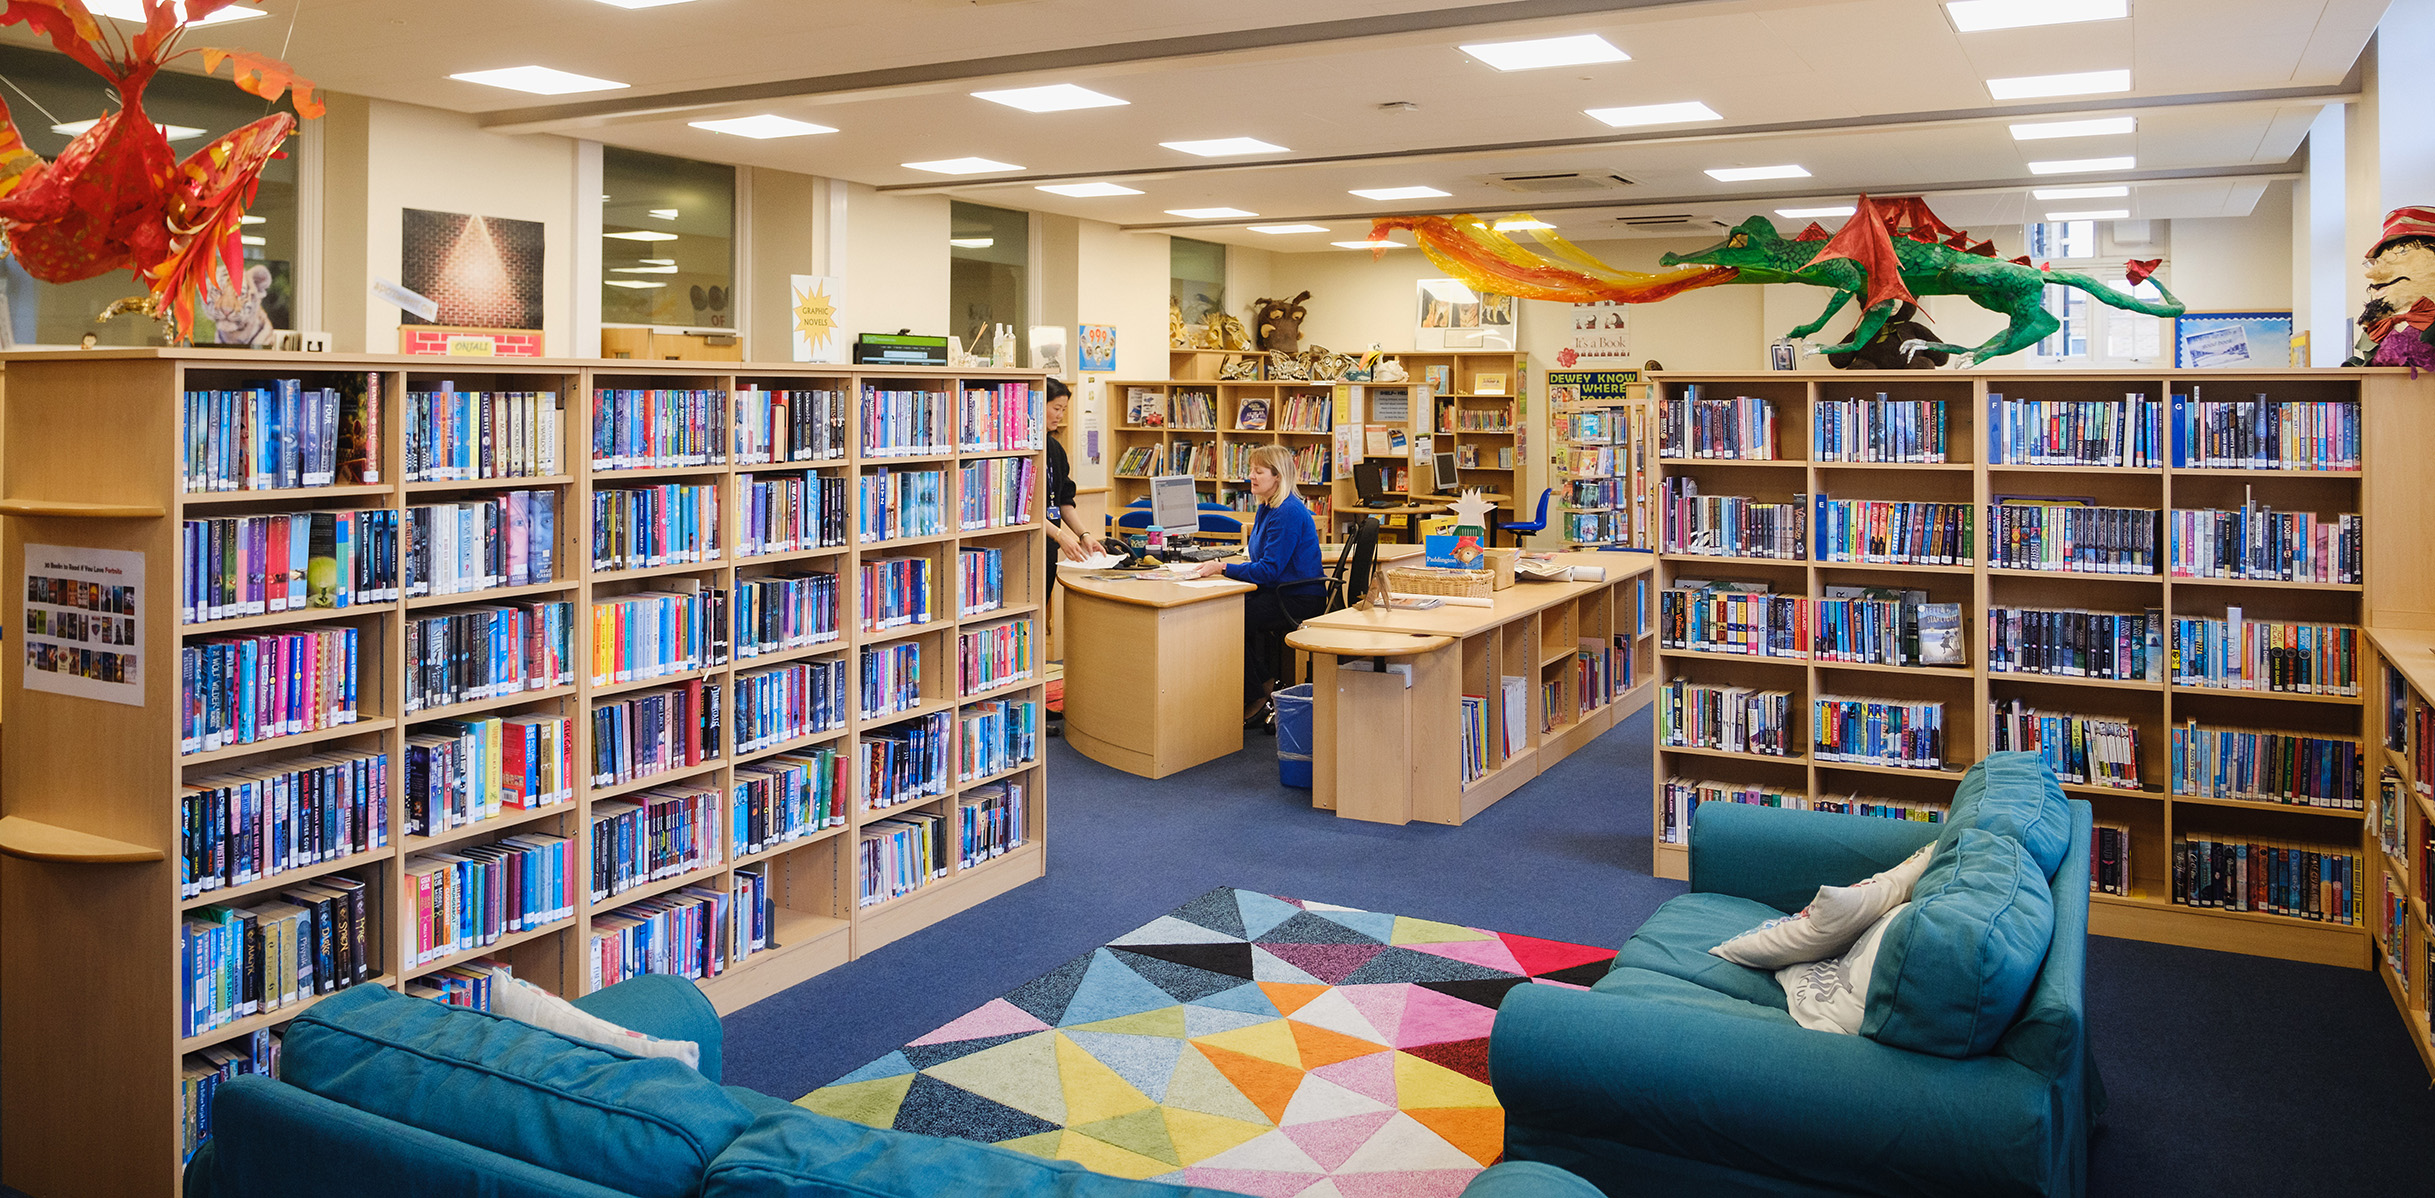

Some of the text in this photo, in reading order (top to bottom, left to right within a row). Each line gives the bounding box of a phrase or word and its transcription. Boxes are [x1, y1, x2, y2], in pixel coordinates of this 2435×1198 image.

[802, 307, 829, 315] GRAPHIC
[455, 342, 488, 352] ONJALI
[1576, 338, 1588, 348] It's
[1600, 336, 1626, 348] Book
[1550, 374, 1591, 383] DEWEY
[1582, 384, 1626, 393] WHERE
[286, 385, 295, 429] ALLEGIANT
[309, 399, 318, 435] INSURGENT
[324, 404, 333, 425] FOUR
[1892, 512, 1901, 551] HEROIC
[2002, 507, 2010, 544] INCARCERON
[211, 658, 220, 709] WOLF WILDER
[265, 790, 273, 809] CHRIS
[217, 840, 225, 868] TWISTER
[321, 927, 330, 956] DARKE
[338, 921, 349, 953] SYREN
[356, 917, 366, 943] FYRE
[300, 937, 308, 967] Physik
